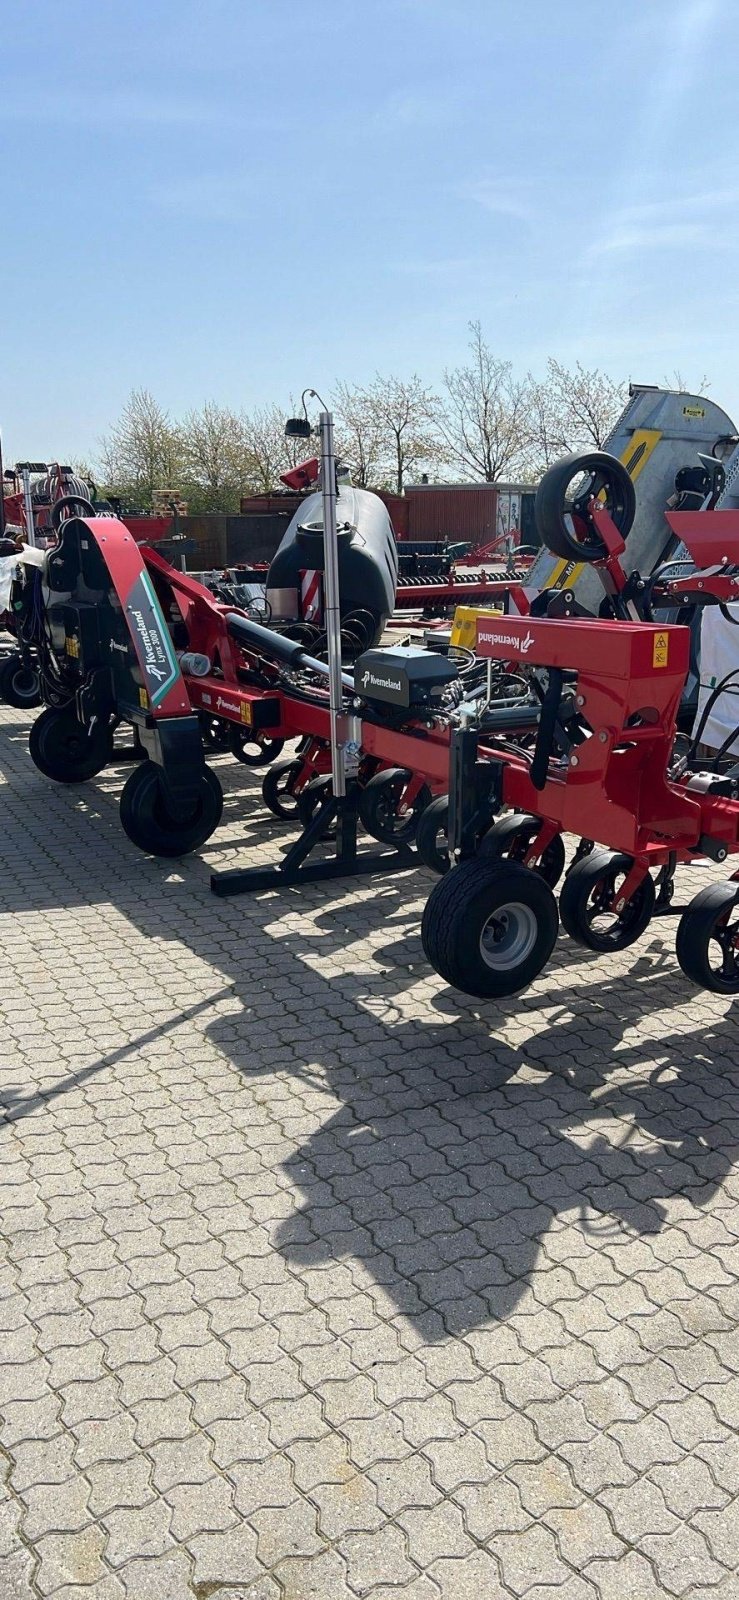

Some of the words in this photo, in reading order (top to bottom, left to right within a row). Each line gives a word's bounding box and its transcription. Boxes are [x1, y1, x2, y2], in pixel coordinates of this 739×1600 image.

[131, 610, 157, 663] Kverneland
[148, 629, 160, 646] 3000
[478, 632, 520, 649] Kverneland
[155, 646, 167, 663] Lynx
[370, 674, 401, 691] Kverneland
